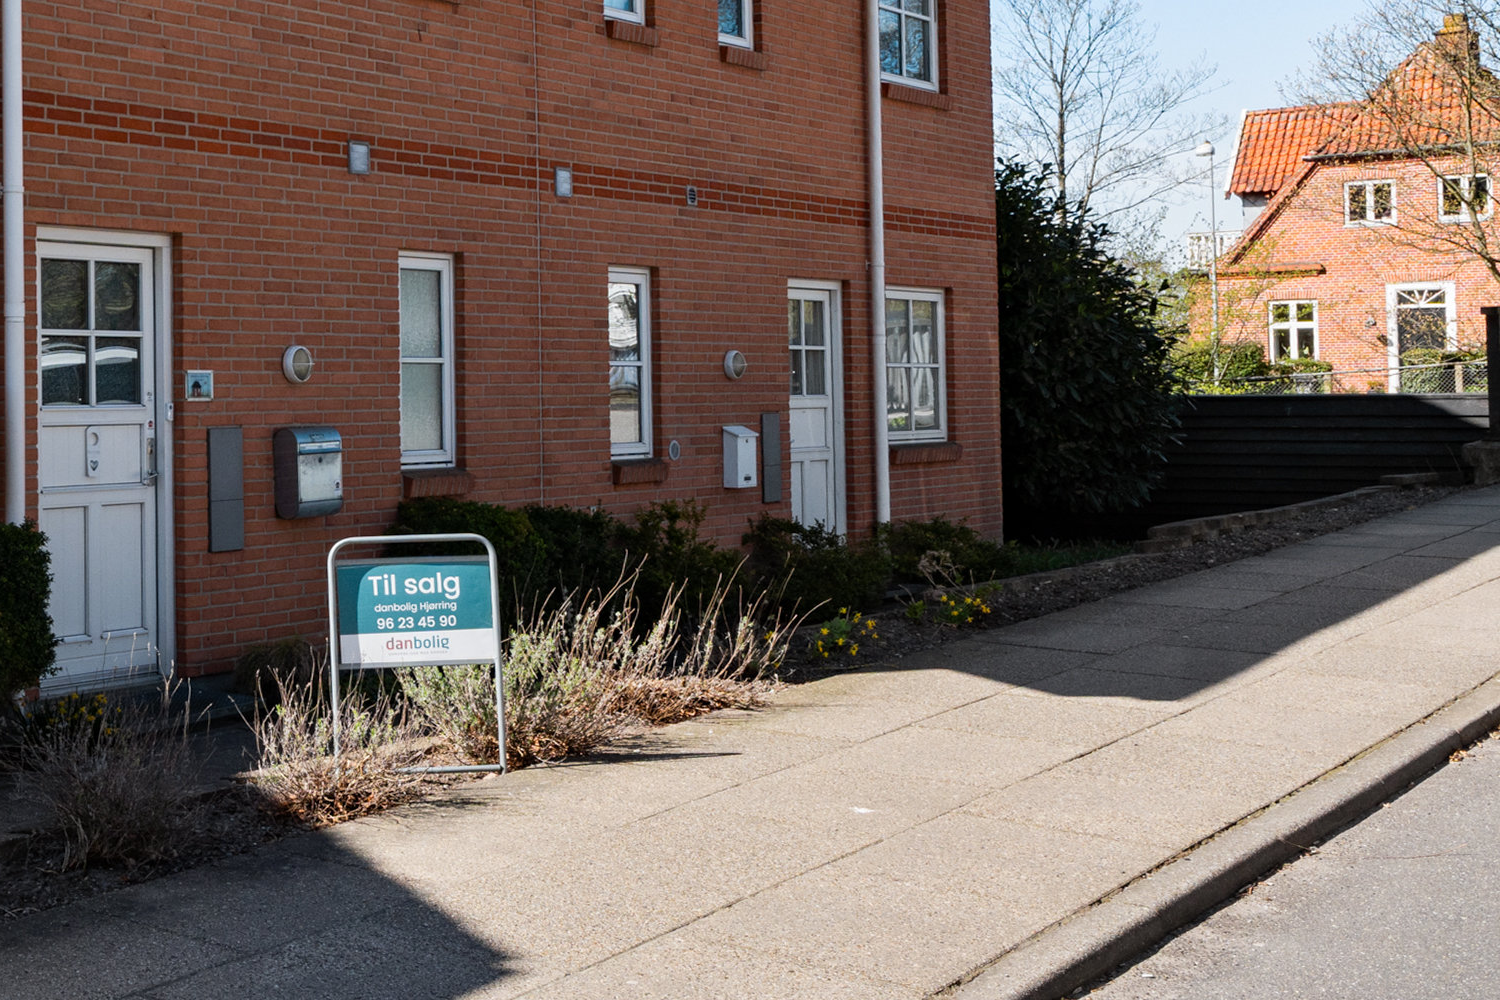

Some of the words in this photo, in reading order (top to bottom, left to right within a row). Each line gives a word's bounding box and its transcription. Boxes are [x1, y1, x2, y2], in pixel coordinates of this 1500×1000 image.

[368, 574, 396, 596] Til
[404, 572, 460, 600] salg
[374, 603, 417, 613] danbolig
[419, 601, 457, 612] Hjørring
[377, 618, 394, 630] 96
[398, 617, 414, 629] 23
[418, 616, 435, 628] 45
[439, 615, 457, 627] 90
[386, 636, 450, 650] danbolig
